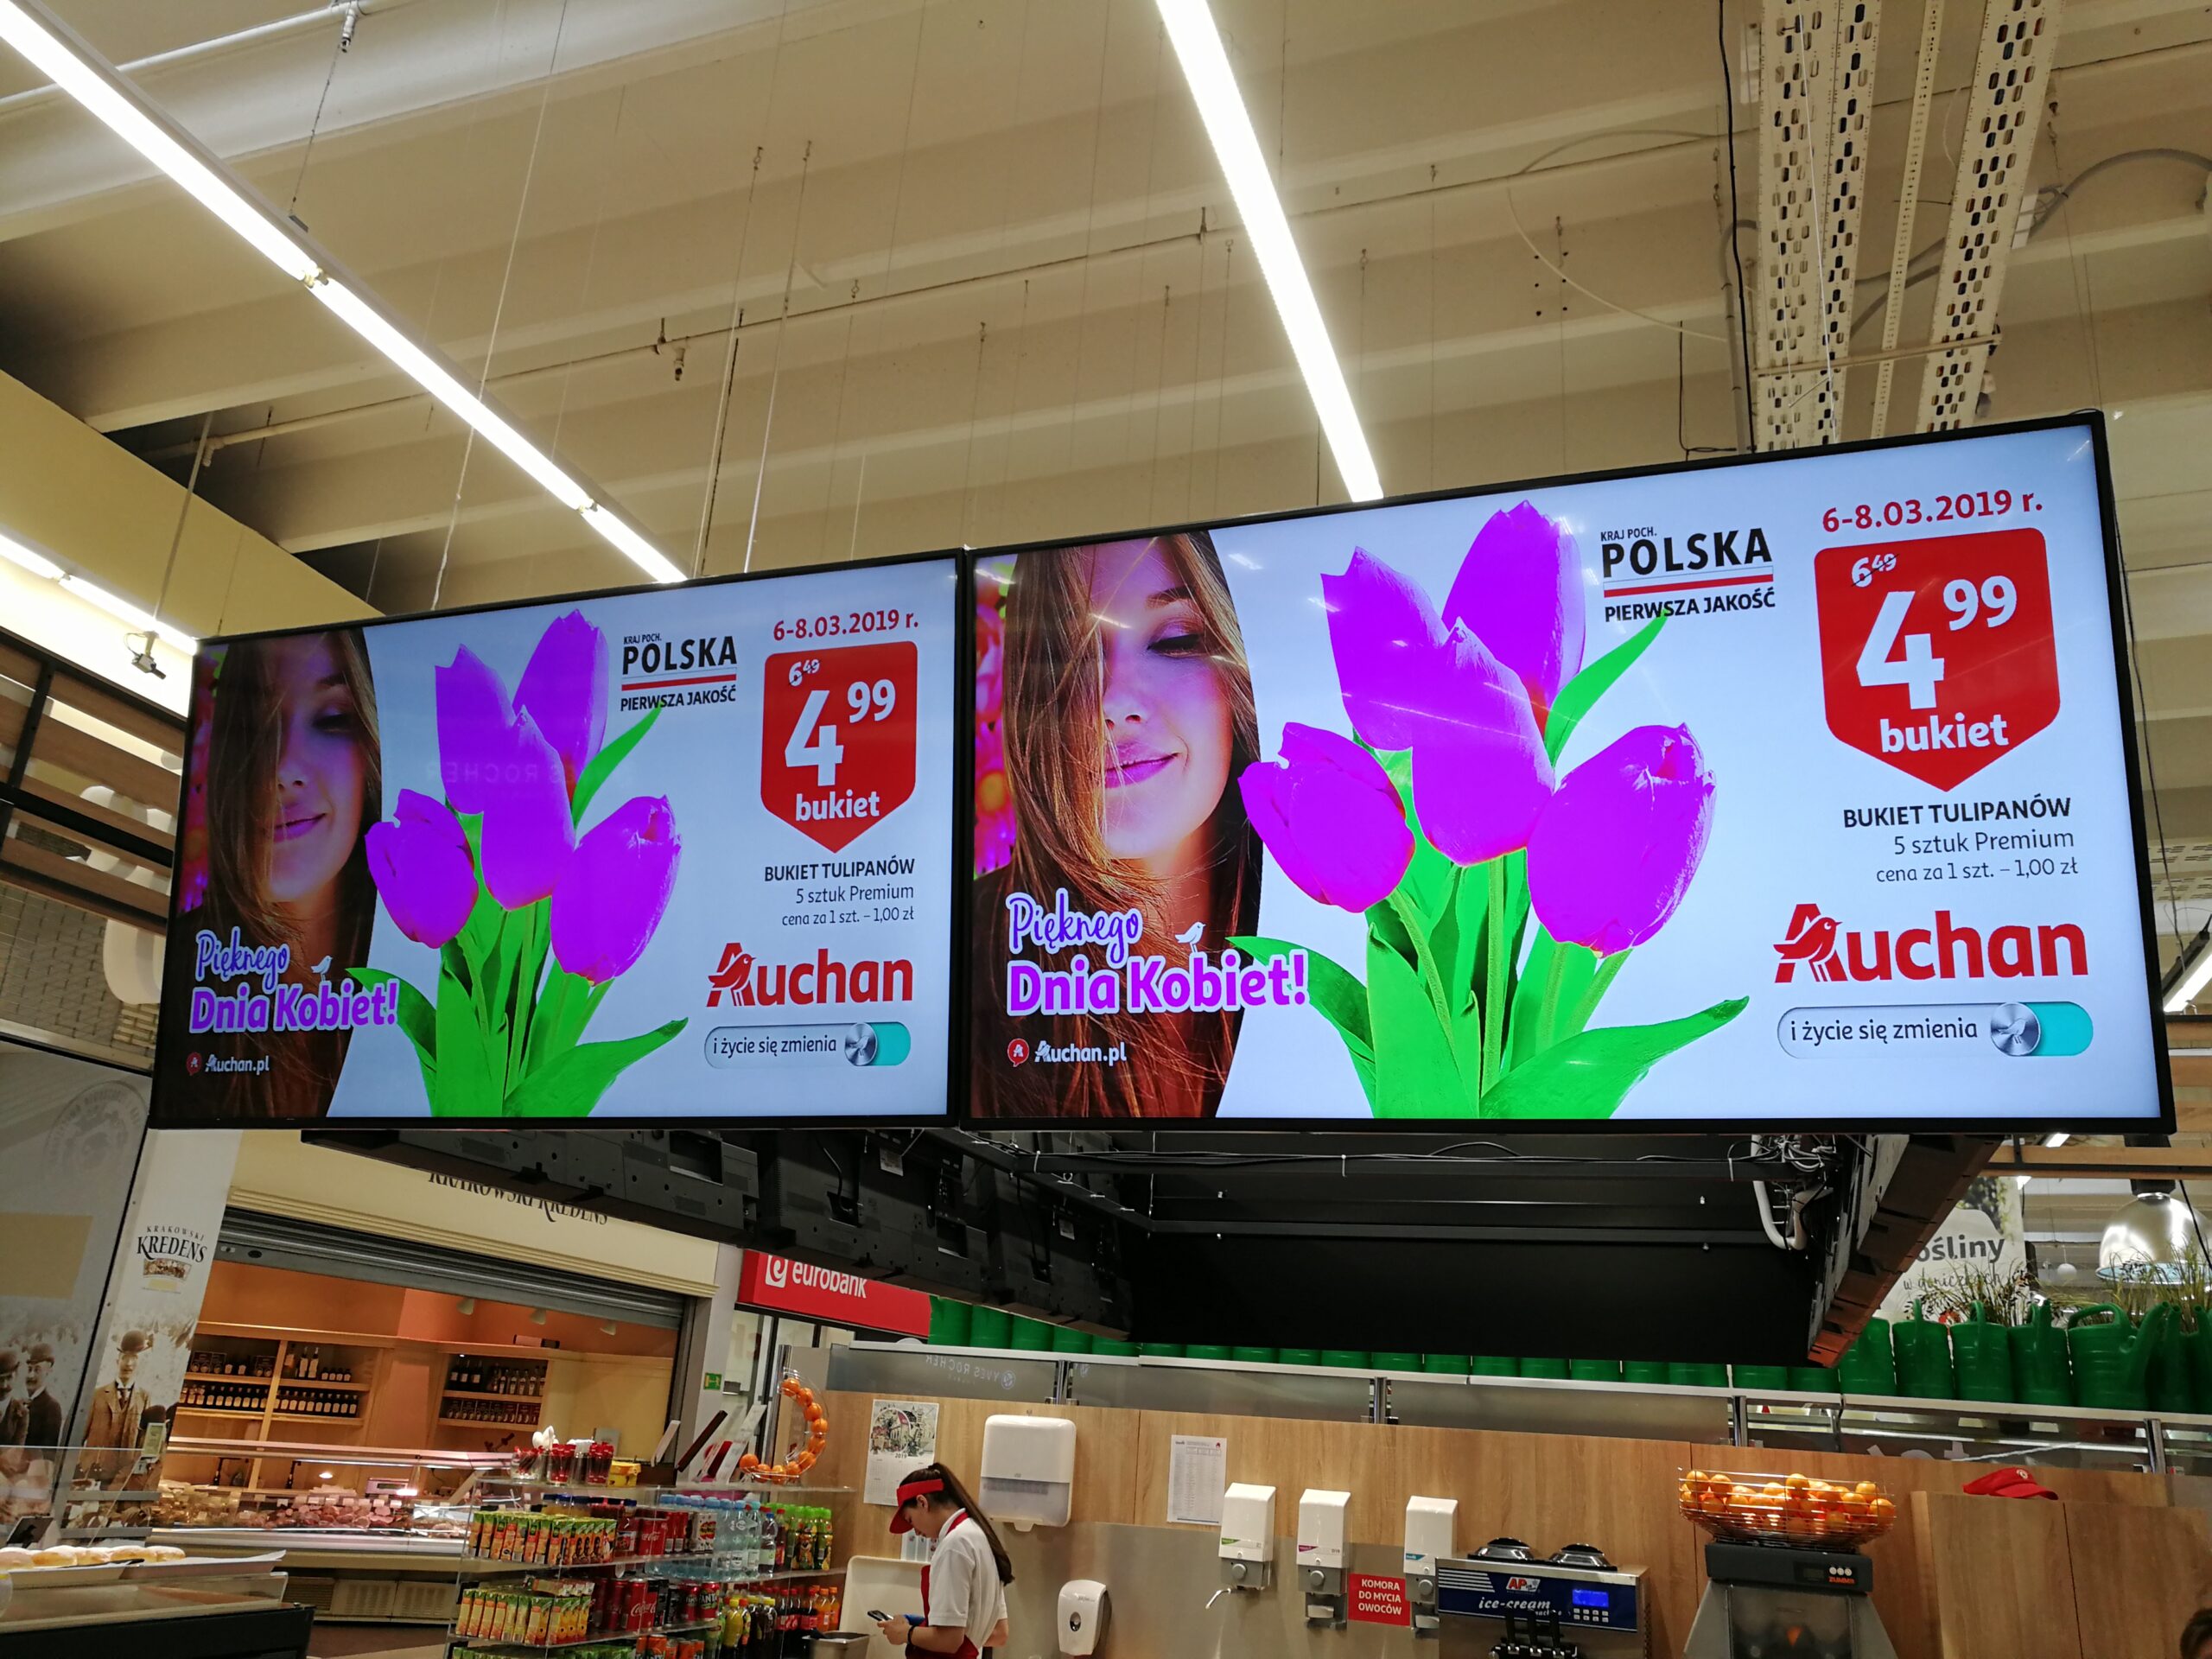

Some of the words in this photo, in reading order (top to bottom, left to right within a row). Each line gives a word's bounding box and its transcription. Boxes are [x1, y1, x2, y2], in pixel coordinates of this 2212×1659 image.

[1822, 489, 2011, 533] 6-8.03.2019
[2022, 492, 2043, 513] r.
[1600, 529, 1624, 542] KRAJ
[1627, 526, 1657, 540] POCH.
[1601, 527, 1772, 578] POLSKA
[1605, 596, 1700, 623] PIERWSZA
[1703, 587, 1777, 613] JAKOŚĆ
[623, 635, 640, 645] KRAJ
[641, 632, 662, 644] POCH.
[773, 609, 899, 641] 6-8.03.2019
[906, 612, 919, 628] r.
[622, 635, 737, 675] POLSKA
[620, 690, 684, 711] PIERWSZA
[687, 683, 736, 706] JAKOŚĆ
[1880, 713, 2009, 753] bukiet
[795, 788, 880, 822] bukiet
[1843, 804, 1923, 828] BUKIET
[1928, 793, 2071, 824] TULIPANÓW
[1894, 836, 1906, 855] 5
[1911, 832, 1970, 855] sztuk
[1975, 829, 2075, 852] Premium
[765, 863, 819, 882] BUKIET
[822, 855, 915, 880] TULIPANÓW
[1876, 867, 1917, 883] cena
[1923, 866, 1943, 881] za
[1948, 862, 1957, 880] 1
[1962, 861, 1994, 880] szt.
[2015, 858, 2055, 880] 1,00
[2060, 856, 2078, 875] zł
[796, 888, 804, 904] 5
[808, 886, 846, 903] sztuk
[849, 883, 914, 902] Premium
[782, 913, 810, 926] cena
[813, 912, 827, 925] za
[829, 910, 835, 924] 1
[839, 910, 860, 924] szt.
[874, 907, 899, 924] 1,00
[902, 906, 914, 921] zł
[1007, 889, 1141, 967] Pięknego
[1773, 903, 2088, 983] Auchan
[197, 928, 289, 992] Pięknego
[706, 942, 913, 1007] Auchan
[1008, 956, 1118, 1014] Dnia
[1128, 950, 1307, 1012] Kobiet!
[190, 984, 269, 1033] Dnia
[274, 980, 398, 1030] Kobiet!
[1790, 1020, 1796, 1041] i
[1802, 1020, 1853, 1046] życie
[1859, 1020, 1887, 1045] się
[1892, 1017, 1978, 1039] zmienia
[713, 1037, 718, 1054] i
[721, 1036, 754, 1059] życie
[758, 1036, 778, 1057] się
[780, 1034, 837, 1052] zmienia
[1035, 1040, 1127, 1066] Auchan.pl
[205, 1053, 270, 1075] Auchan.pl
[146, 1225, 205, 1242] KRAKOWSKI
[137, 1235, 208, 1263] KREDENS
[1917, 1234, 2005, 1263] ośliny
[1358, 1590, 1372, 1599] DO
[1373, 1592, 1402, 1604] MYCIA
[1361, 1578, 1401, 1592] KOMORA
[1508, 1578, 1528, 1590] AP
[1357, 1602, 1402, 1616] OWOCÓW
[1478, 1596, 1551, 1611] ice-cream
